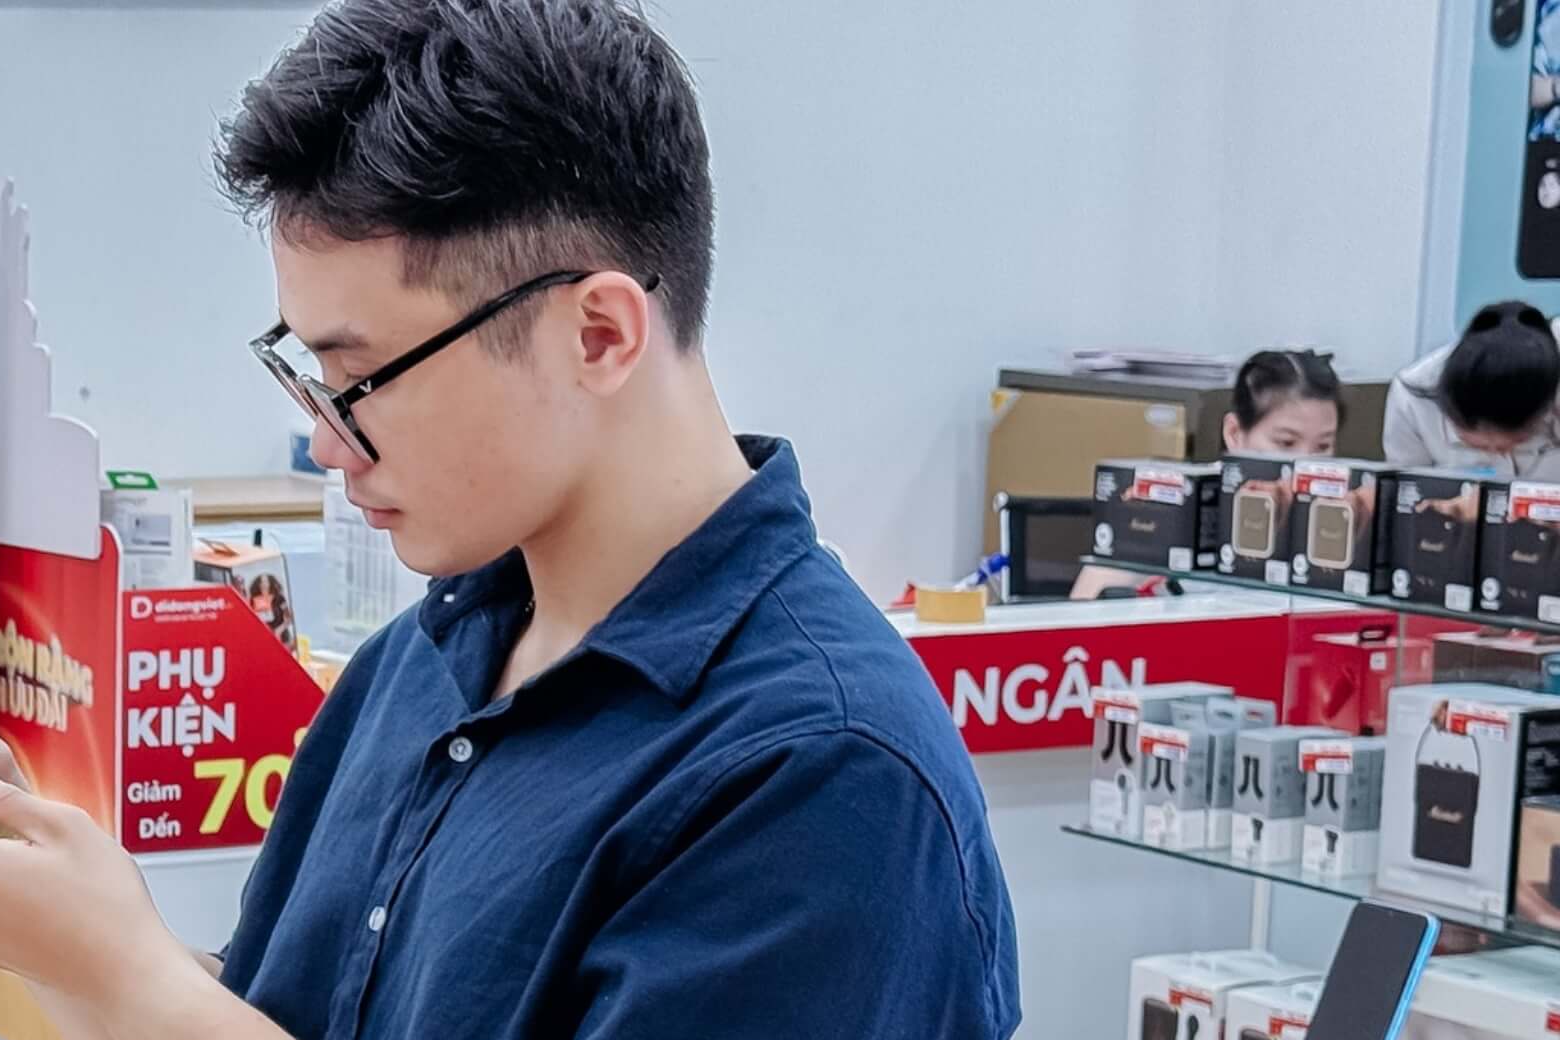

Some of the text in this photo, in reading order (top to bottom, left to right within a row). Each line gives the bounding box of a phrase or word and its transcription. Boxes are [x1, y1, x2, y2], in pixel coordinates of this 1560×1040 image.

[128, 647, 225, 699] PHỤ
[953, 646, 1147, 728] NGÂN
[128, 692, 236, 757] KIỆN
[128, 780, 182, 804] Giảm
[194, 733, 307, 834] 70
[138, 812, 182, 839] Đến
